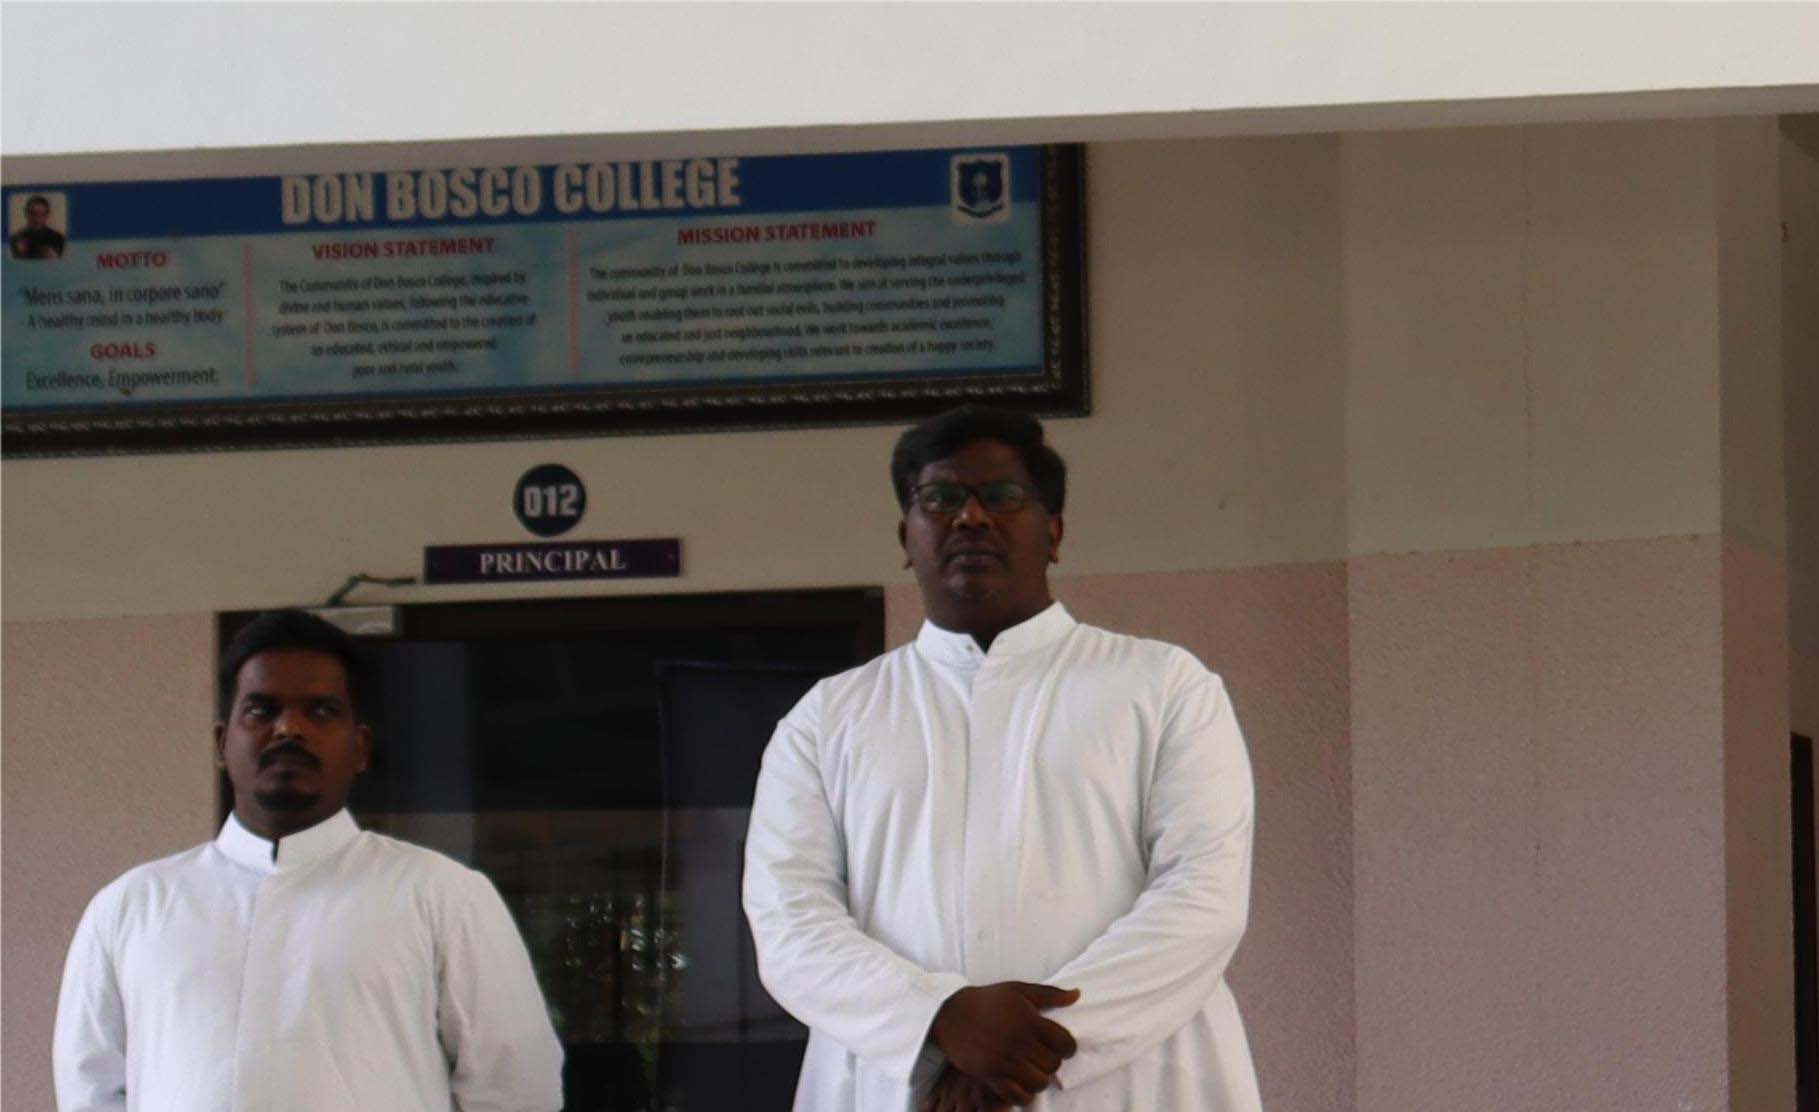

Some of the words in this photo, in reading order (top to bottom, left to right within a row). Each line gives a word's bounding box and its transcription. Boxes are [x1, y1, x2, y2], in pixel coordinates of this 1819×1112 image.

[280, 172, 376, 224] DON
[387, 166, 541, 220] BOSCO
[553, 157, 742, 213] COLLEGE
[678, 226, 759, 245] MISSION
[764, 220, 877, 241] STATEMENT
[97, 251, 169, 270] MOTTO
[312, 242, 379, 260] VISION
[383, 238, 496, 257] STATEMENT
[90, 342, 156, 360] GOALS
[522, 484, 579, 518] 012
[480, 549, 627, 575] PRINCIPAL
